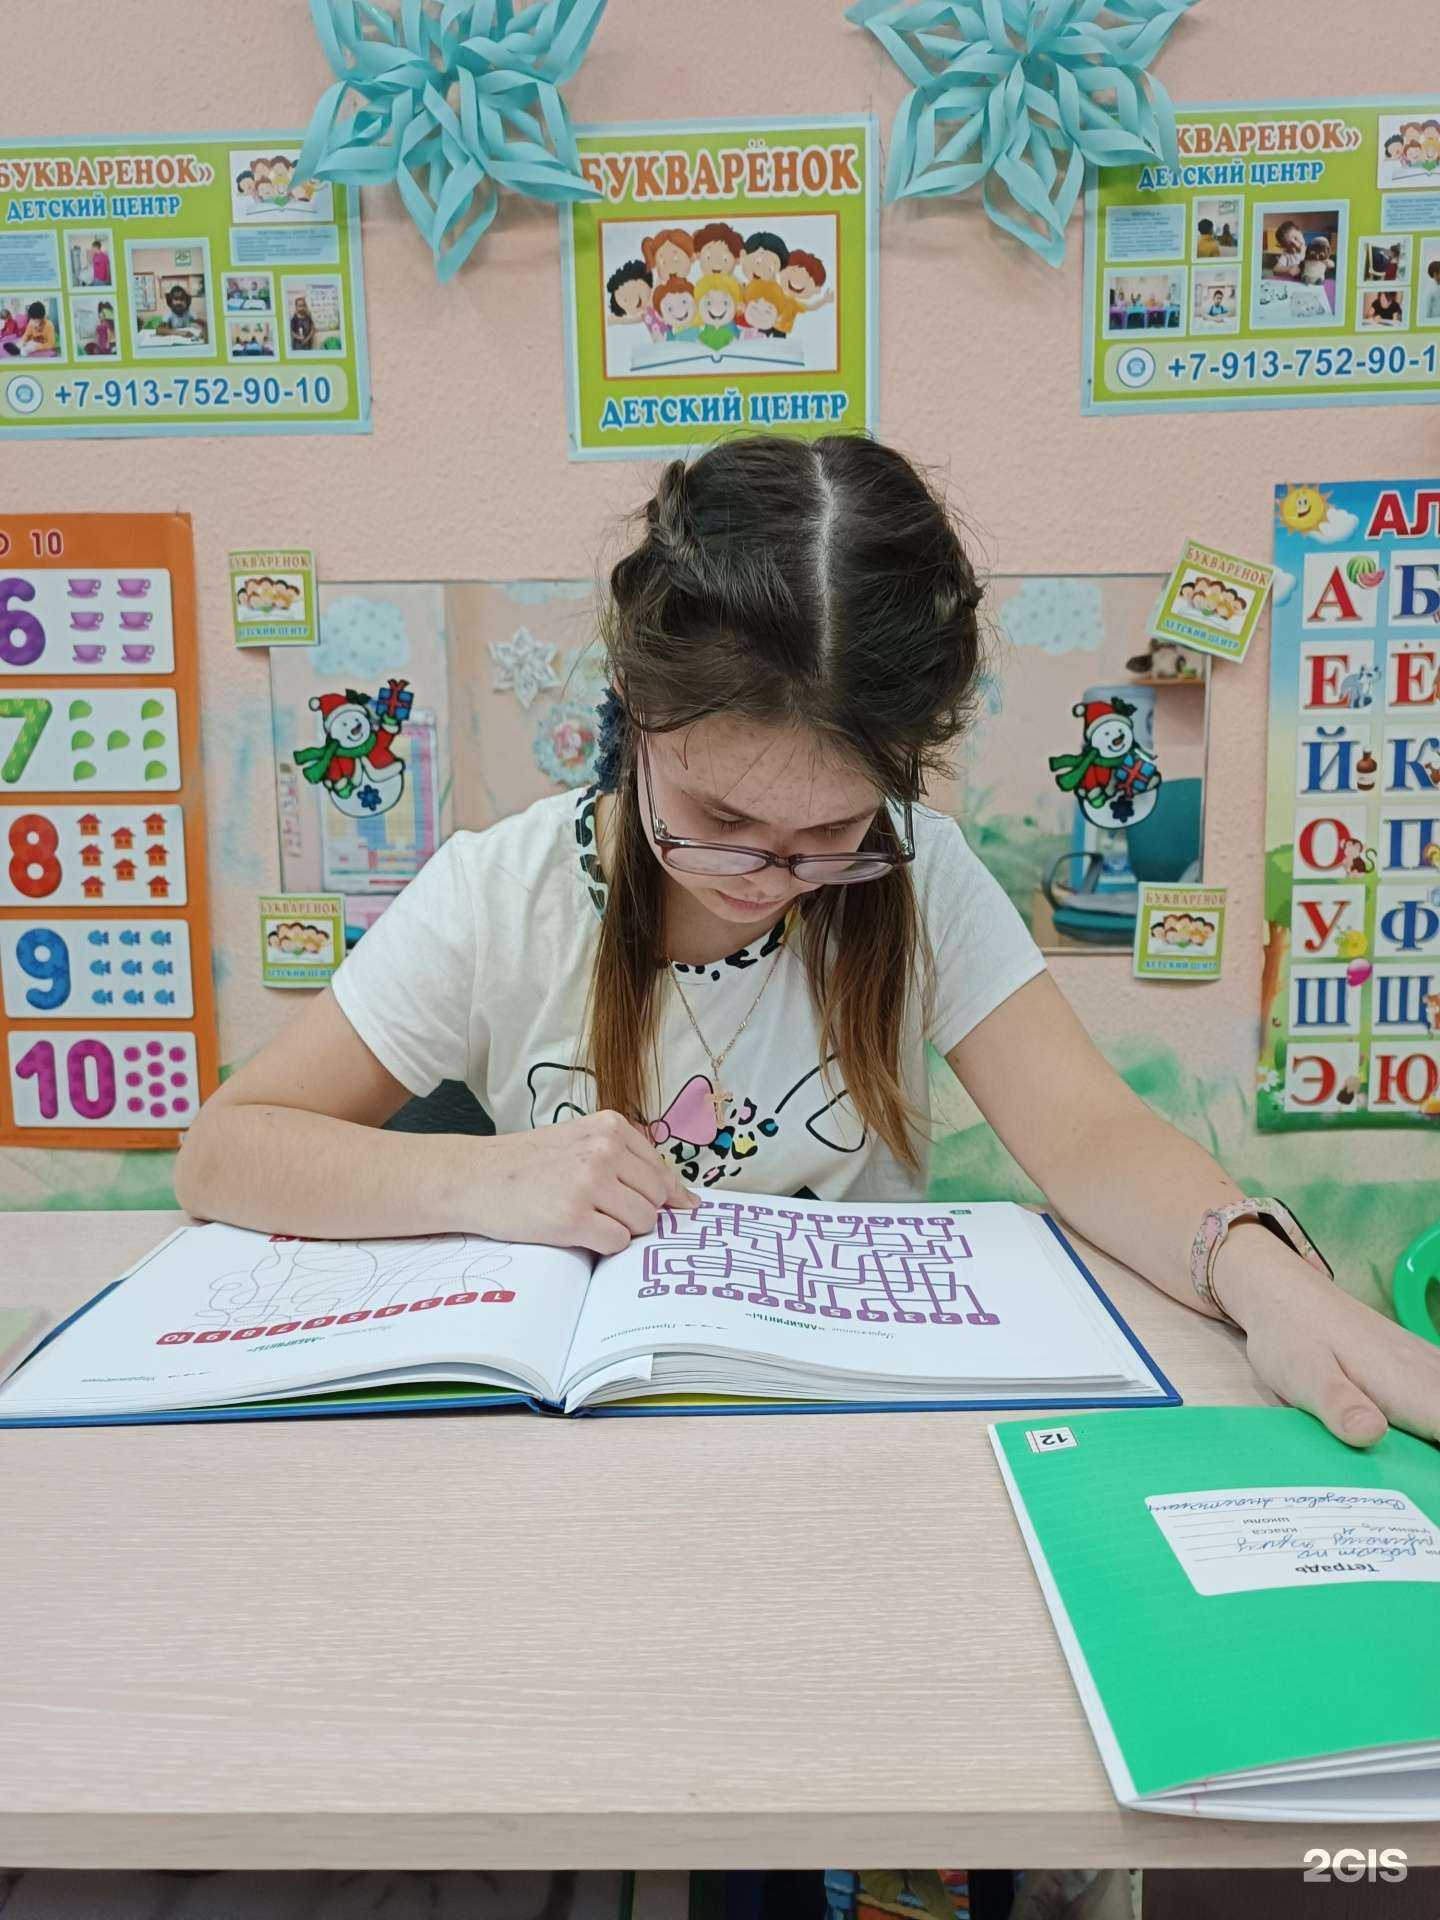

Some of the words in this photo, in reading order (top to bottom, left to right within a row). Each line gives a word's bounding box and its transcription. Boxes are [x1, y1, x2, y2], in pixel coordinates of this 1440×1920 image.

[1176, 122, 1361, 154] КВАРЕНОК»
[580, 140, 859, 198] БУКВАРЁНОК
[1139, 160, 1245, 189] ДЕТСКИЙ
[1251, 161, 1324, 186] ЦЕНТР
[7, 194, 106, 221] ДЕТСКИЙ
[112, 197, 180, 219] ЦЕНТР
[1168, 344, 1435, 380] +7-913-752-90-1
[55, 376, 331, 407] +7-913-752-90-10
[601, 390, 741, 428] ДЕТСКИЙ
[750, 393, 847, 423] ЦЕНТР
[31, 530, 62, 556] 10
[1307, 565, 1361, 622] А
[1392, 564, 1440, 620] Б
[0, 577, 46, 666] 6
[1304, 654, 1351, 709] Е
[1389, 643, 1436, 707] Ё
[0, 699, 52, 783] 7
[1301, 726, 1360, 794] Й
[1386, 738, 1440, 793] К
[8, 814, 63, 898] 8
[1299, 818, 1351, 872] О
[1383, 819, 1440, 871] П
[1298, 901, 1349, 952] У
[1381, 901, 1440, 952] Ф
[15, 928, 71, 1010] 9
[1293, 978, 1350, 1027] Ш
[15, 1039, 116, 1119] 10
[1291, 1055, 1336, 1105] Э
[1374, 1054, 1439, 1105] Ю
[1040, 1431, 1069, 1447] 12
[1251, 1528, 1298, 1537] класса
[1295, 1560, 1379, 1576] Тетрадь
